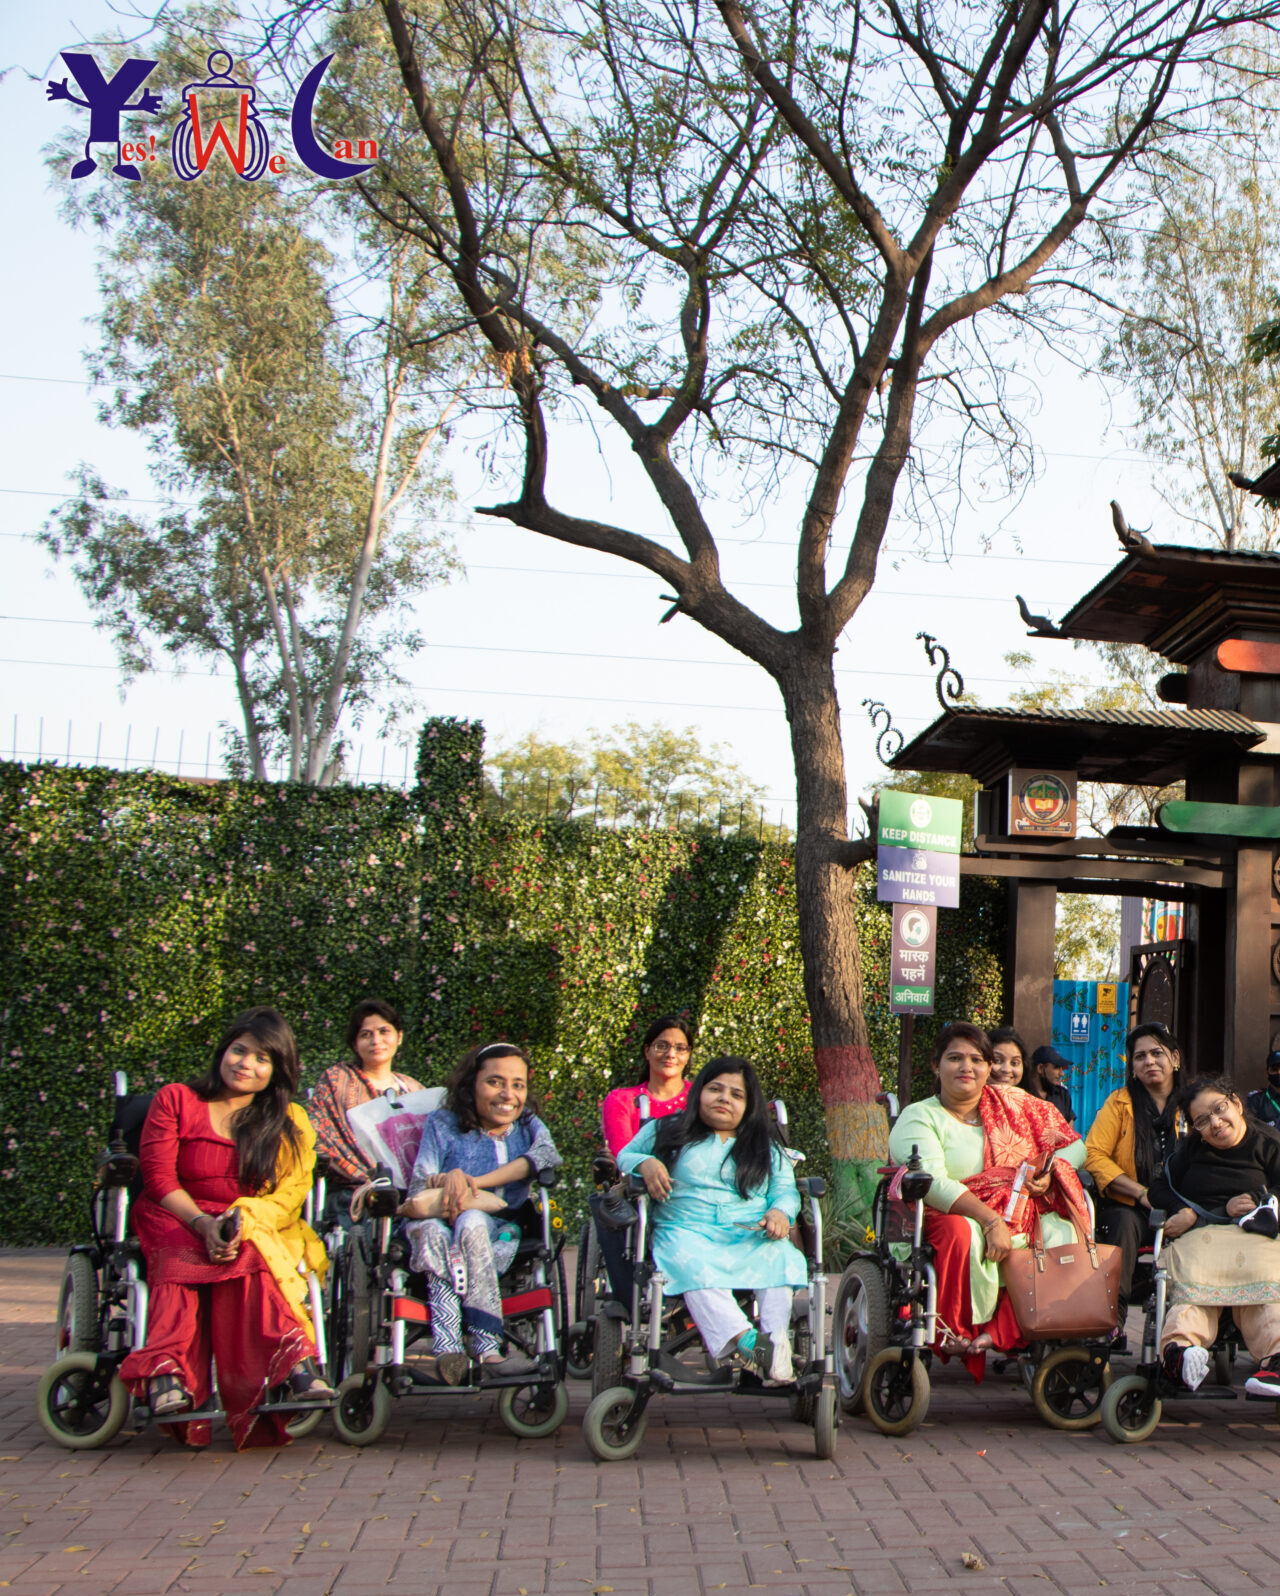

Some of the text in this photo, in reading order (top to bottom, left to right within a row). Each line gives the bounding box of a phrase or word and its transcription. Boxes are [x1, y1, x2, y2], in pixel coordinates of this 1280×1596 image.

[882, 827, 957, 848] KEEP DISTANCE
[882, 869, 956, 887] SANITIZE YOUR
[902, 888, 936, 902] HANDS
[899, 949, 929, 962] मास्क
[901, 964, 926, 981] पहनें
[895, 989, 930, 1003] अनिवार्य
